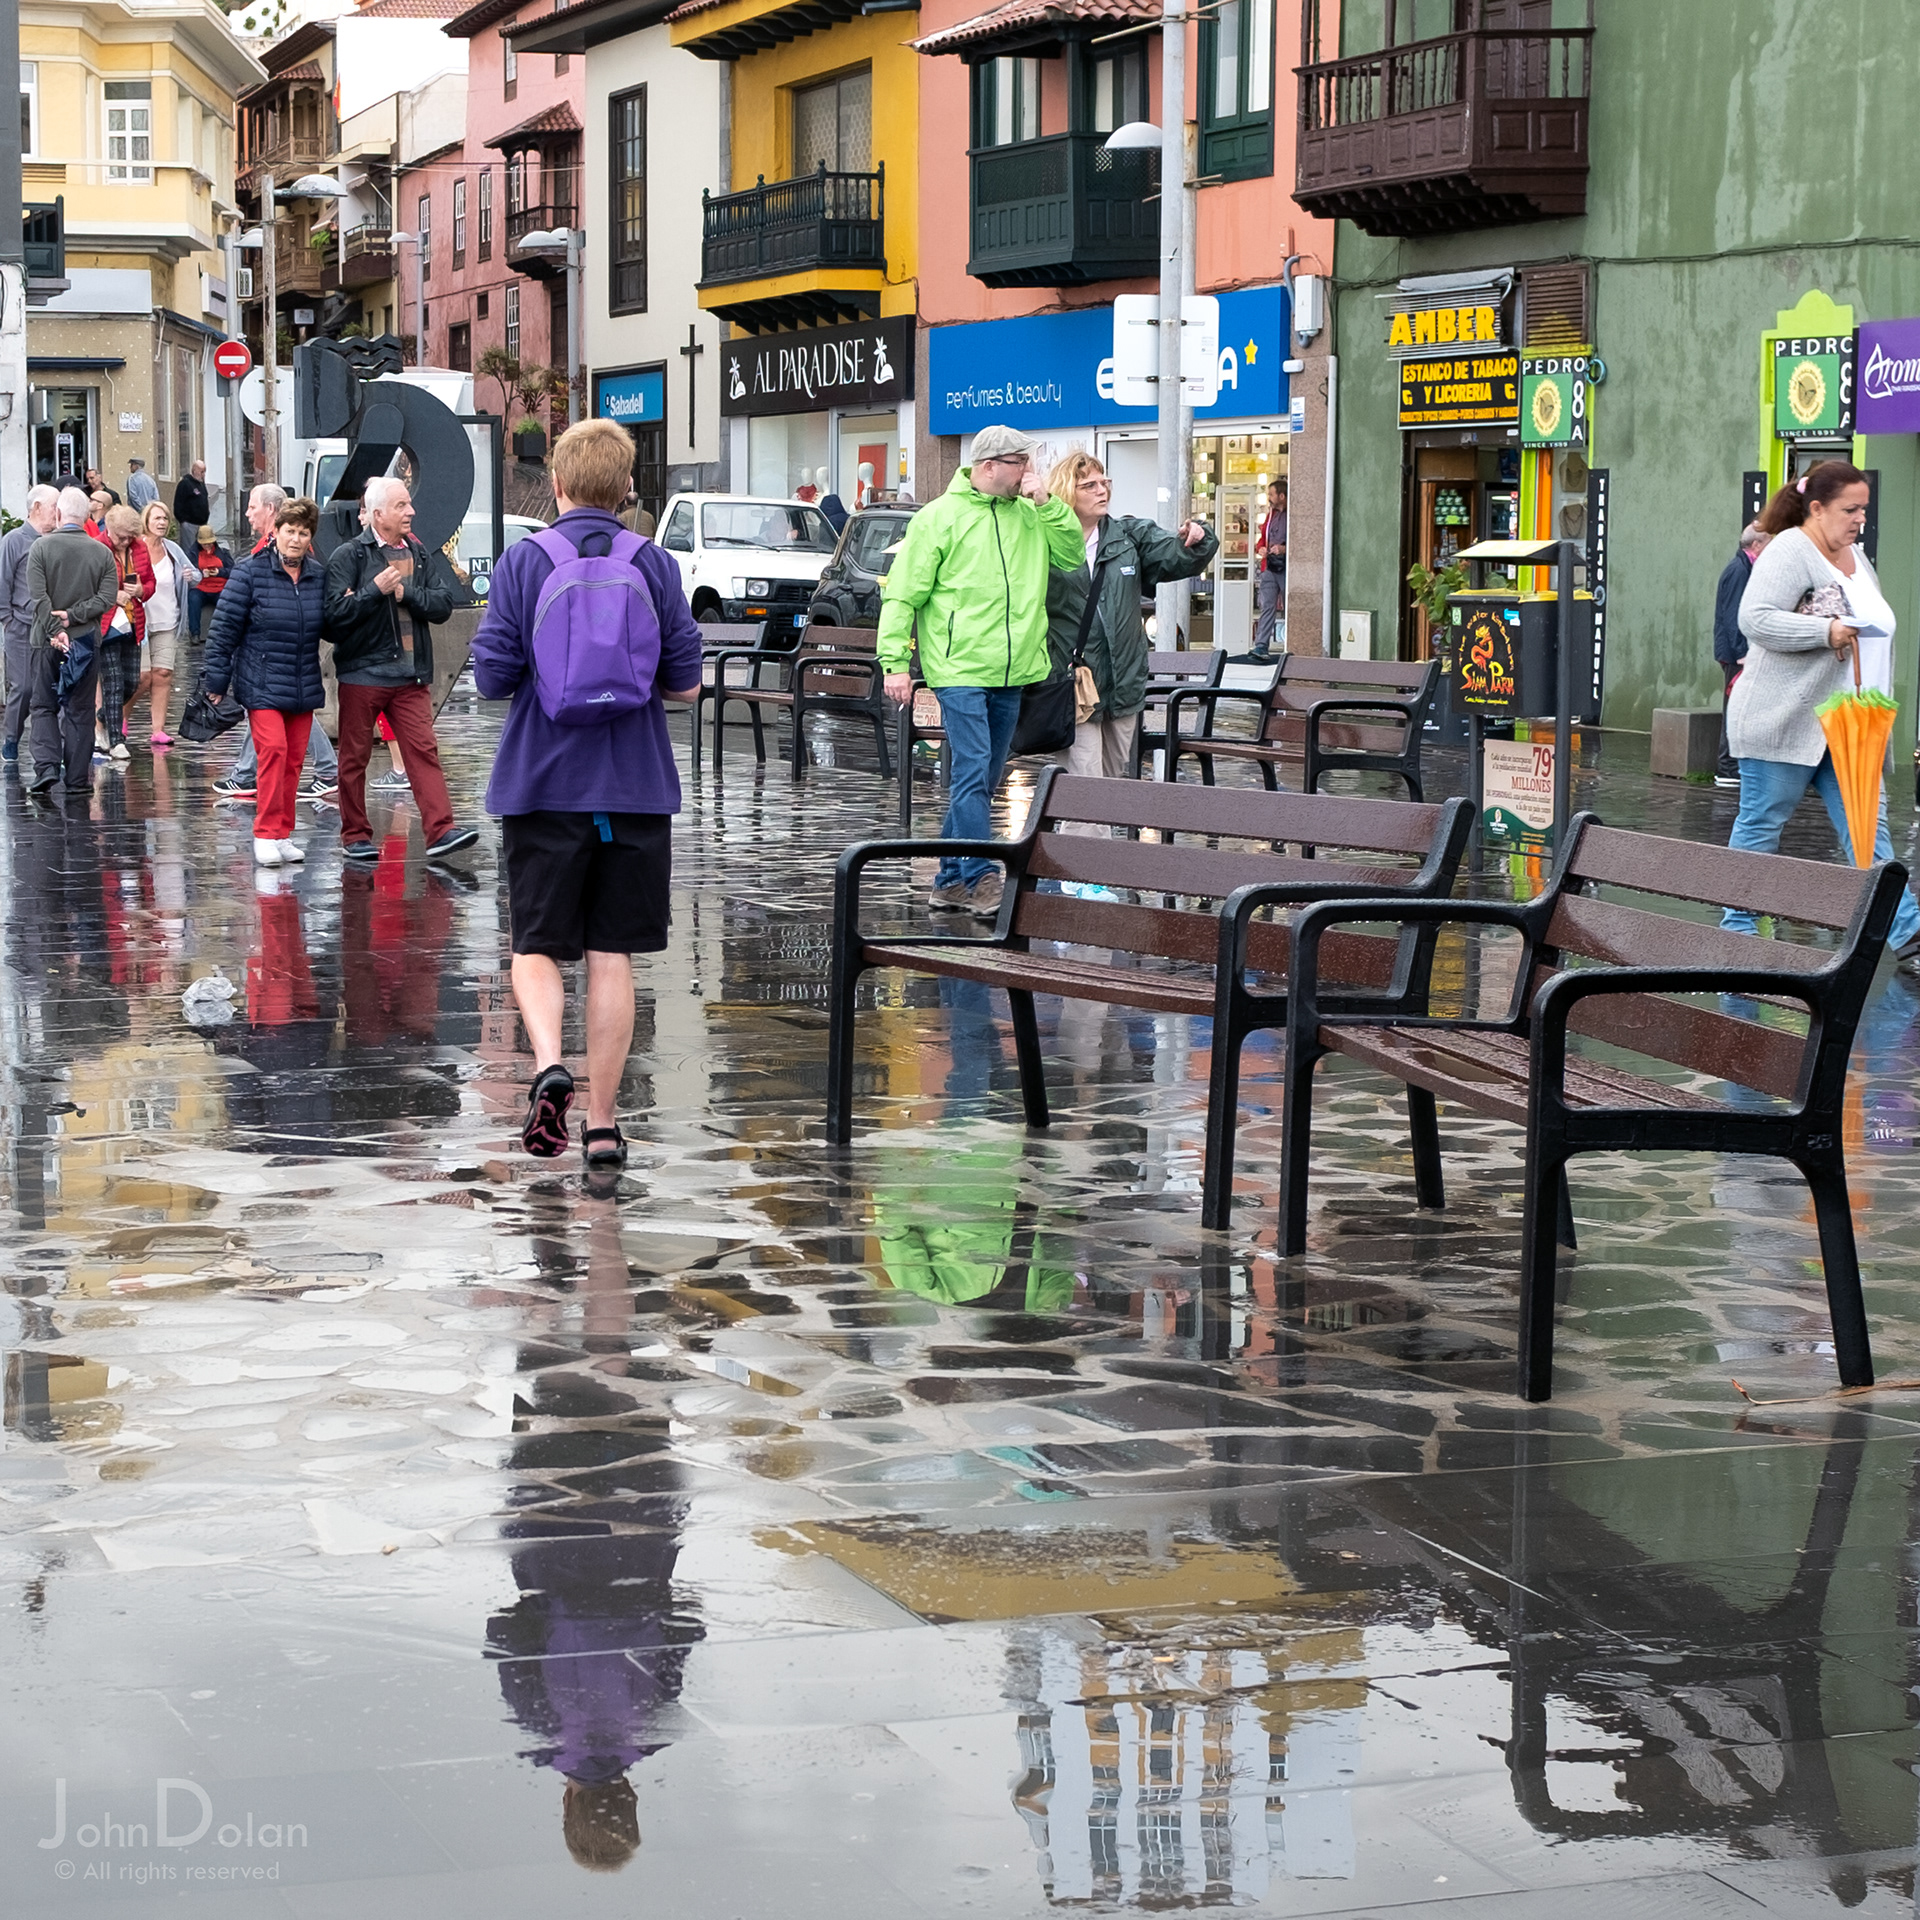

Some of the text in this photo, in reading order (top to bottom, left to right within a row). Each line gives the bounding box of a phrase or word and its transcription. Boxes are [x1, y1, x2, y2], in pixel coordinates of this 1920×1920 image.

[1389, 305, 1496, 345] AMBER
[753, 338, 866, 399] AL PARADISE
[1402, 357, 1518, 383] ESTANCO DE TABACO
[1522, 357, 1585, 375] PEDRO
[610, 392, 644, 416] Sabadell
[946, 379, 1062, 409] perfumes & beauty
[1424, 386, 1432, 404] Y
[1435, 382, 1492, 404] LICORERIA
[1597, 478, 1605, 582] TRABAJO
[1593, 612, 1603, 699] MANUAL
[1533, 747, 1552, 777] 79
[1511, 776, 1551, 793] MILLONES
